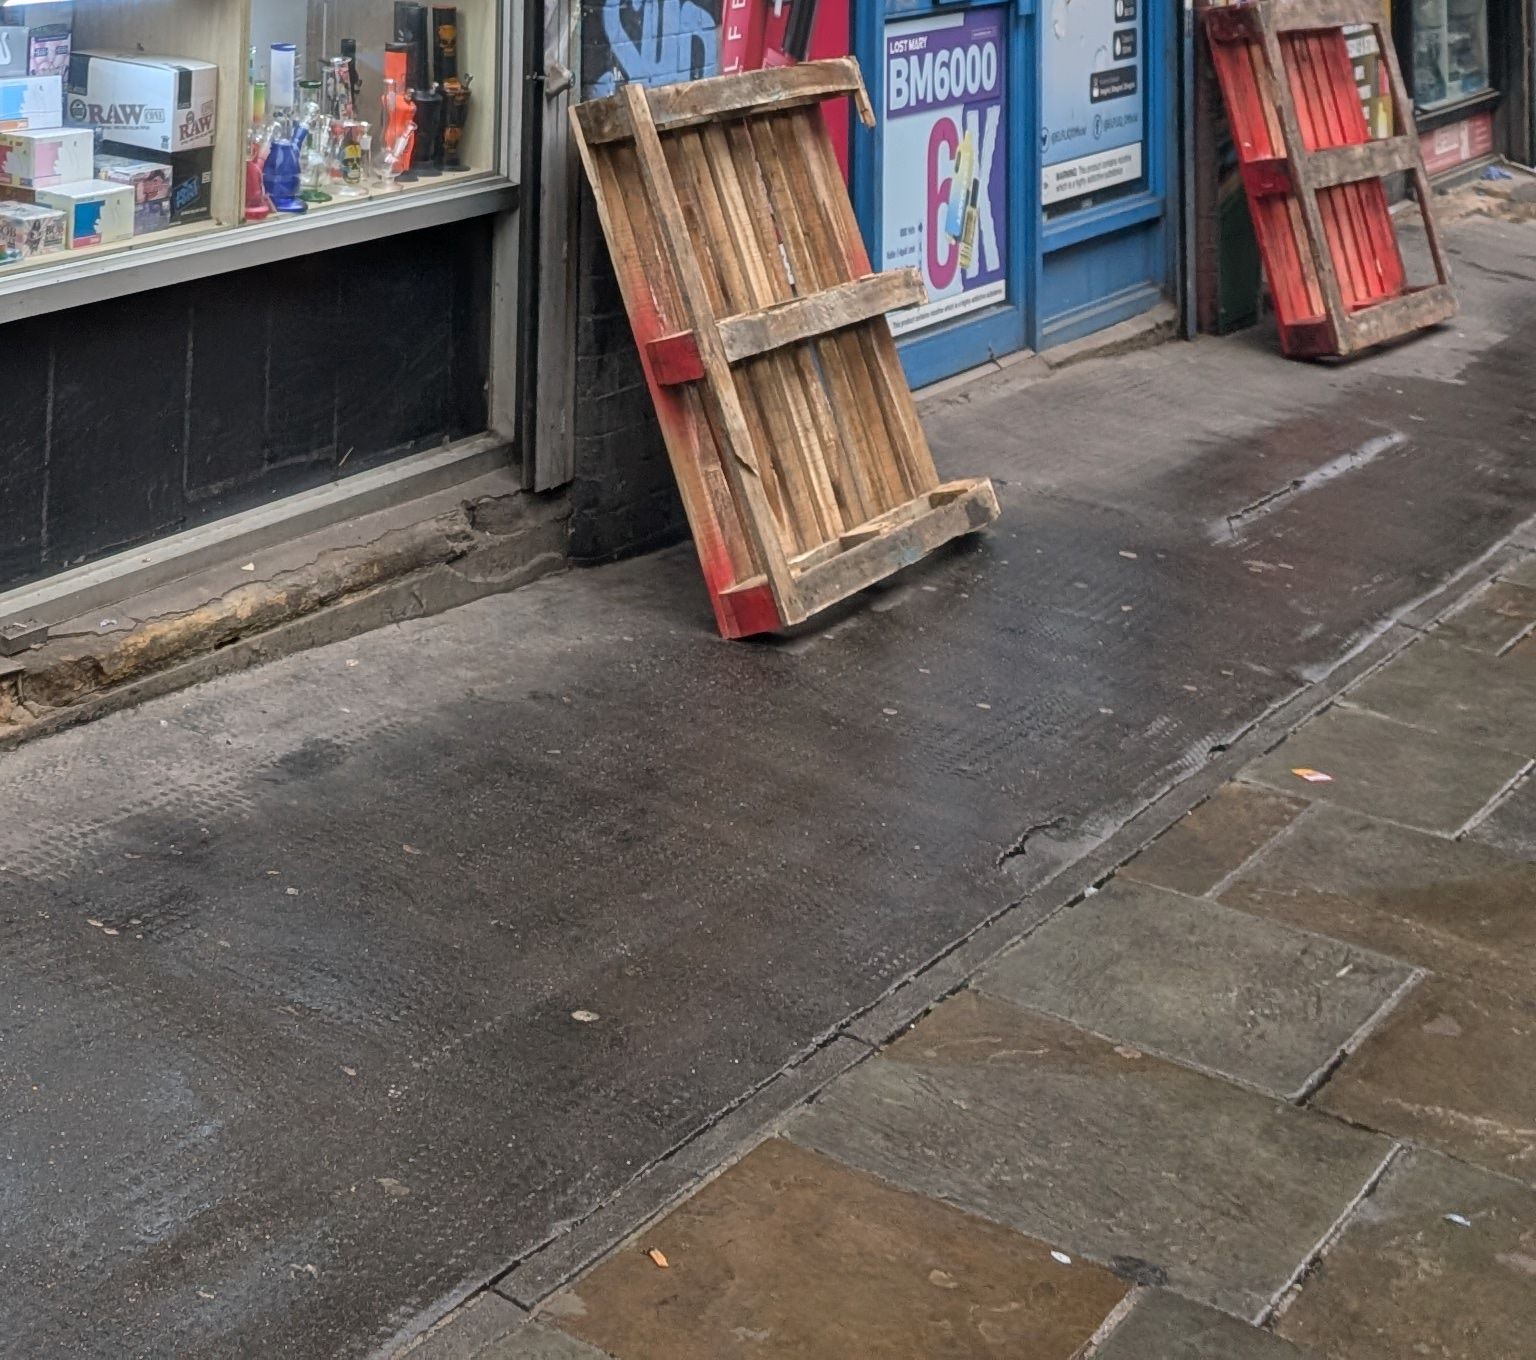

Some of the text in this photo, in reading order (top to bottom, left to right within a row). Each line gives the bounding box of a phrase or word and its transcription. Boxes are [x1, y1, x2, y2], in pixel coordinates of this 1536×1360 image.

[889, 35, 928, 55] LOST MARY
[888, 41, 998, 112] BM6000
[87, 103, 144, 125] RAW
[179, 113, 213, 140] RAW
